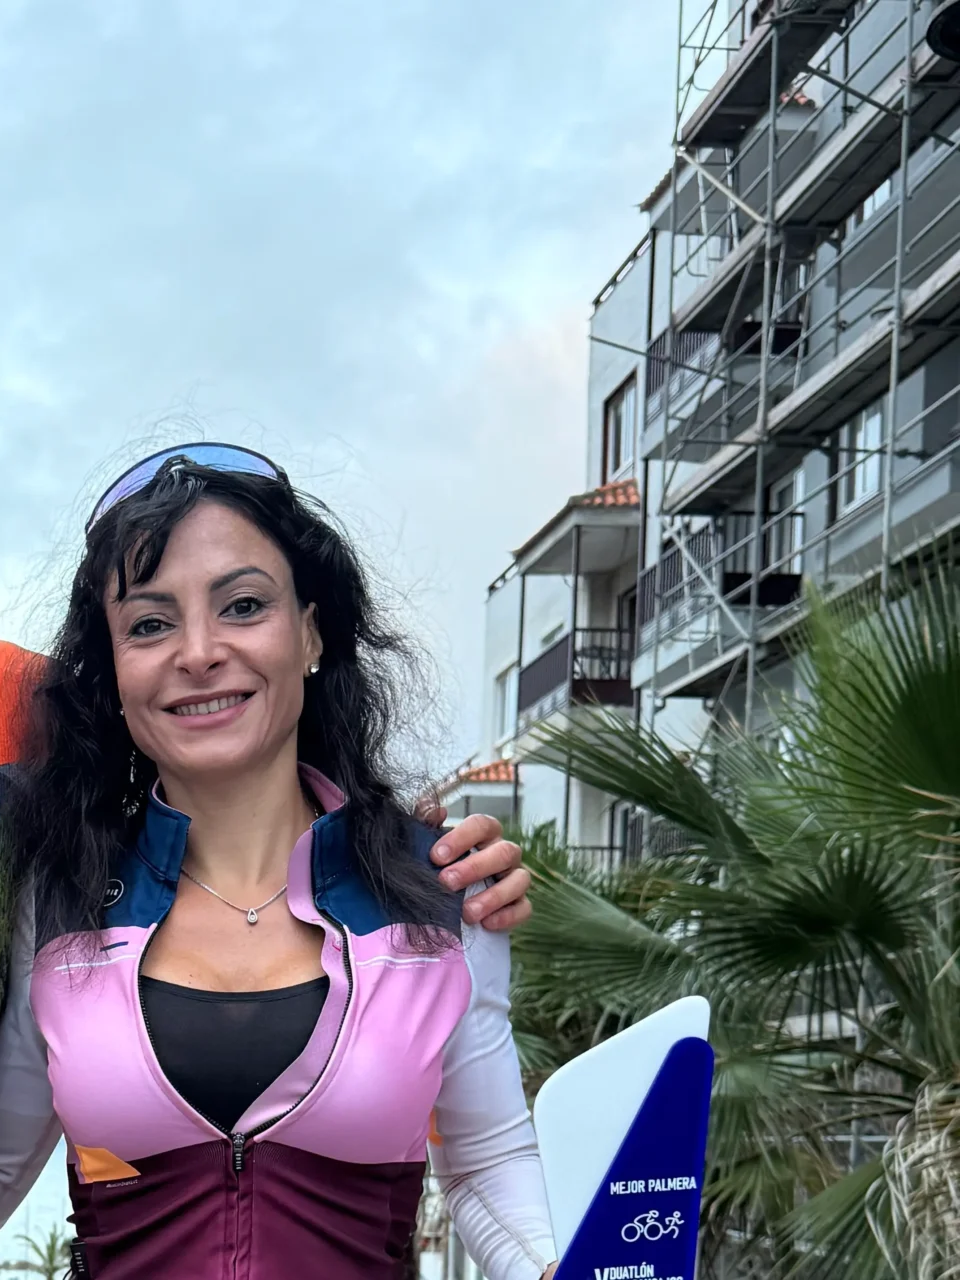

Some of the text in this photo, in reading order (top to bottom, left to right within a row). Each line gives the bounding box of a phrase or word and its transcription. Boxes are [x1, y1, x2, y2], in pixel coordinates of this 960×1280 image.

[610, 1176, 697, 1195] MEJOR PALMERA
[609, 1261, 655, 1280] DUATLÓN
